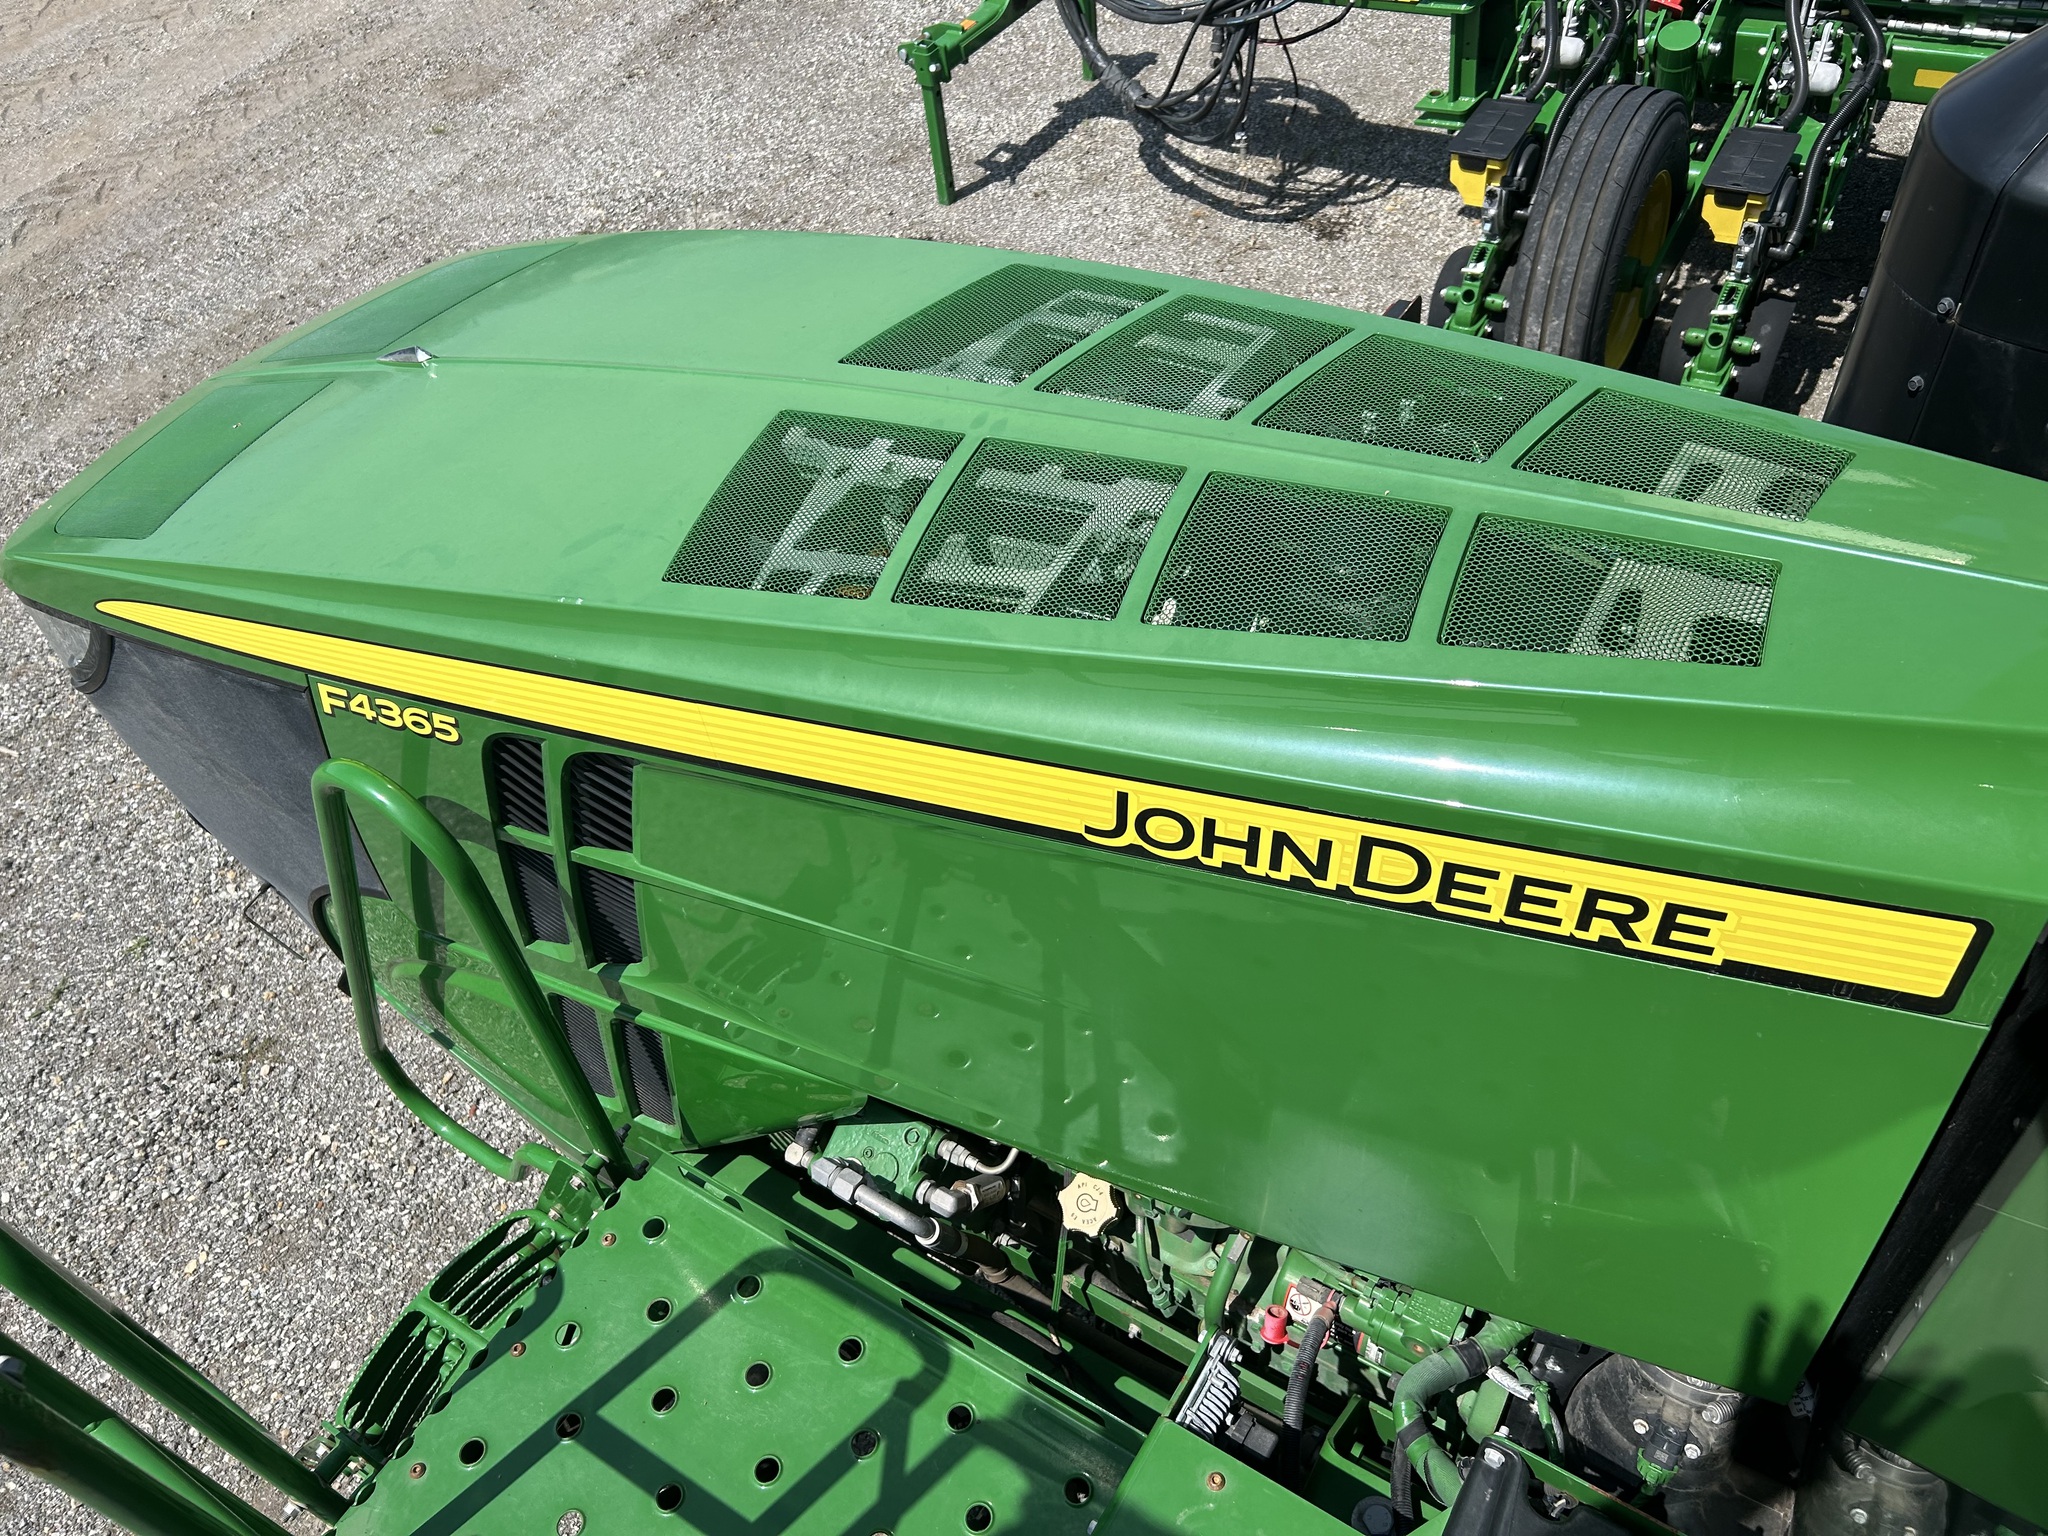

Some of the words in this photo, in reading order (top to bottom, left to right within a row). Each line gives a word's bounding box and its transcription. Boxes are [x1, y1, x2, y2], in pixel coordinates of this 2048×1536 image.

[317, 682, 462, 745] F4365
[1084, 790, 1334, 882] JOHN
[1352, 834, 1729, 957] DEERE
